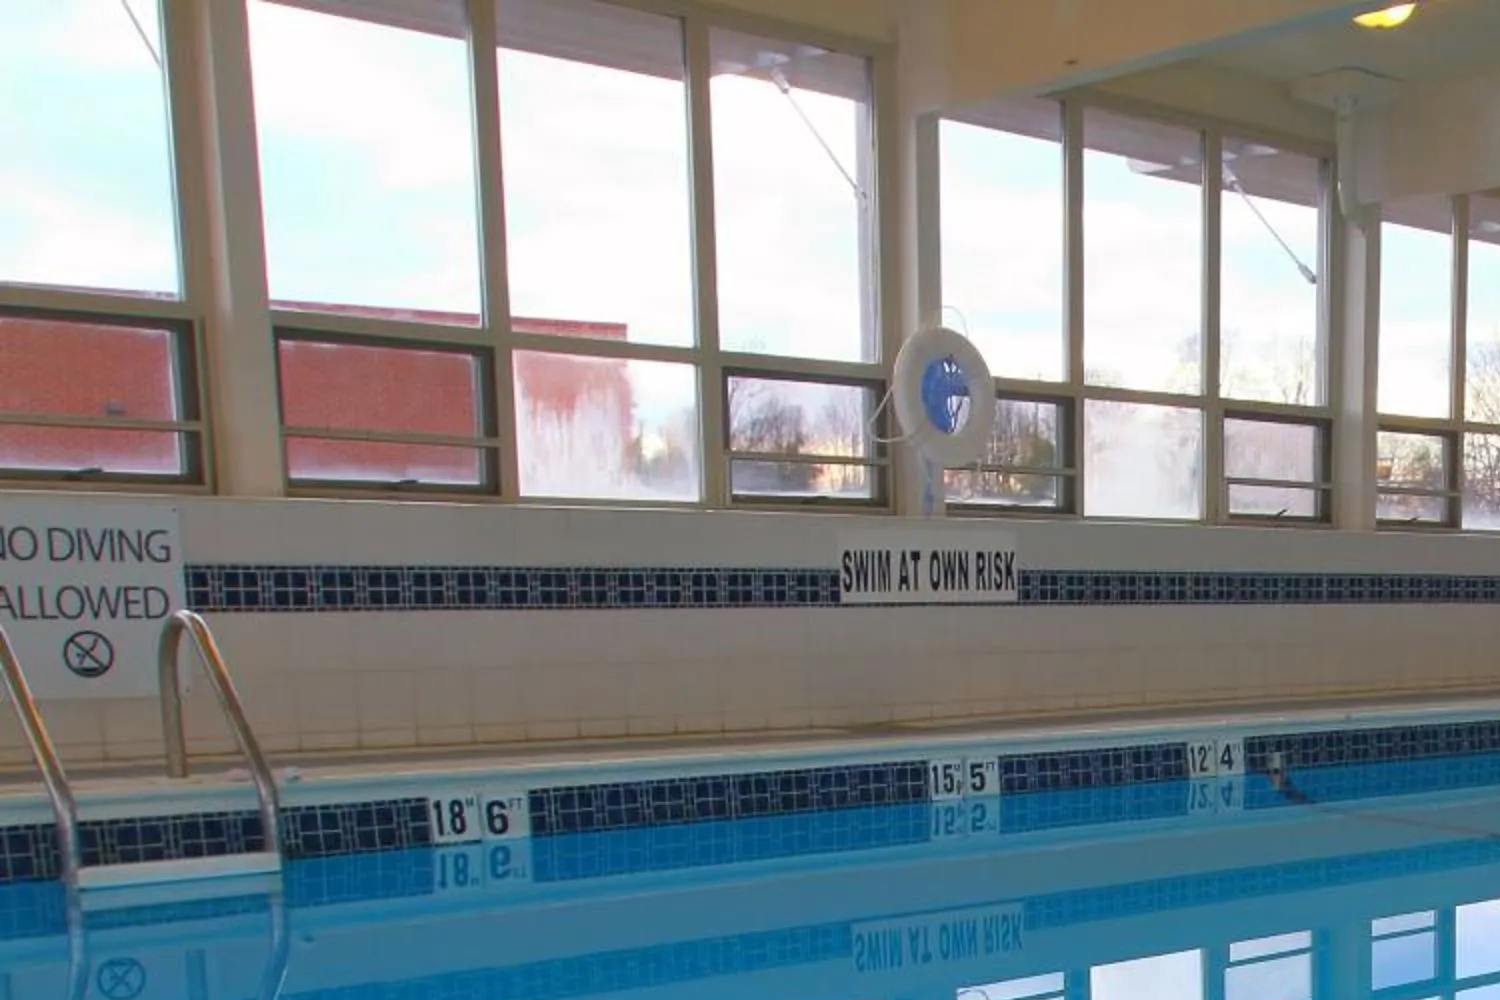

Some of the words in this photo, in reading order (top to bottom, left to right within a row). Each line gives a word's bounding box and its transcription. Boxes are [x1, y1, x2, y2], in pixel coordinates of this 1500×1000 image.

[0, 526, 38, 562] O
[47, 527, 171, 564] DIVING
[842, 550, 891, 592] SWIM
[898, 550, 921, 592] AT
[929, 550, 969, 591] OWN
[976, 550, 1016, 591] RISK
[0, 585, 170, 620] ALLOWED
